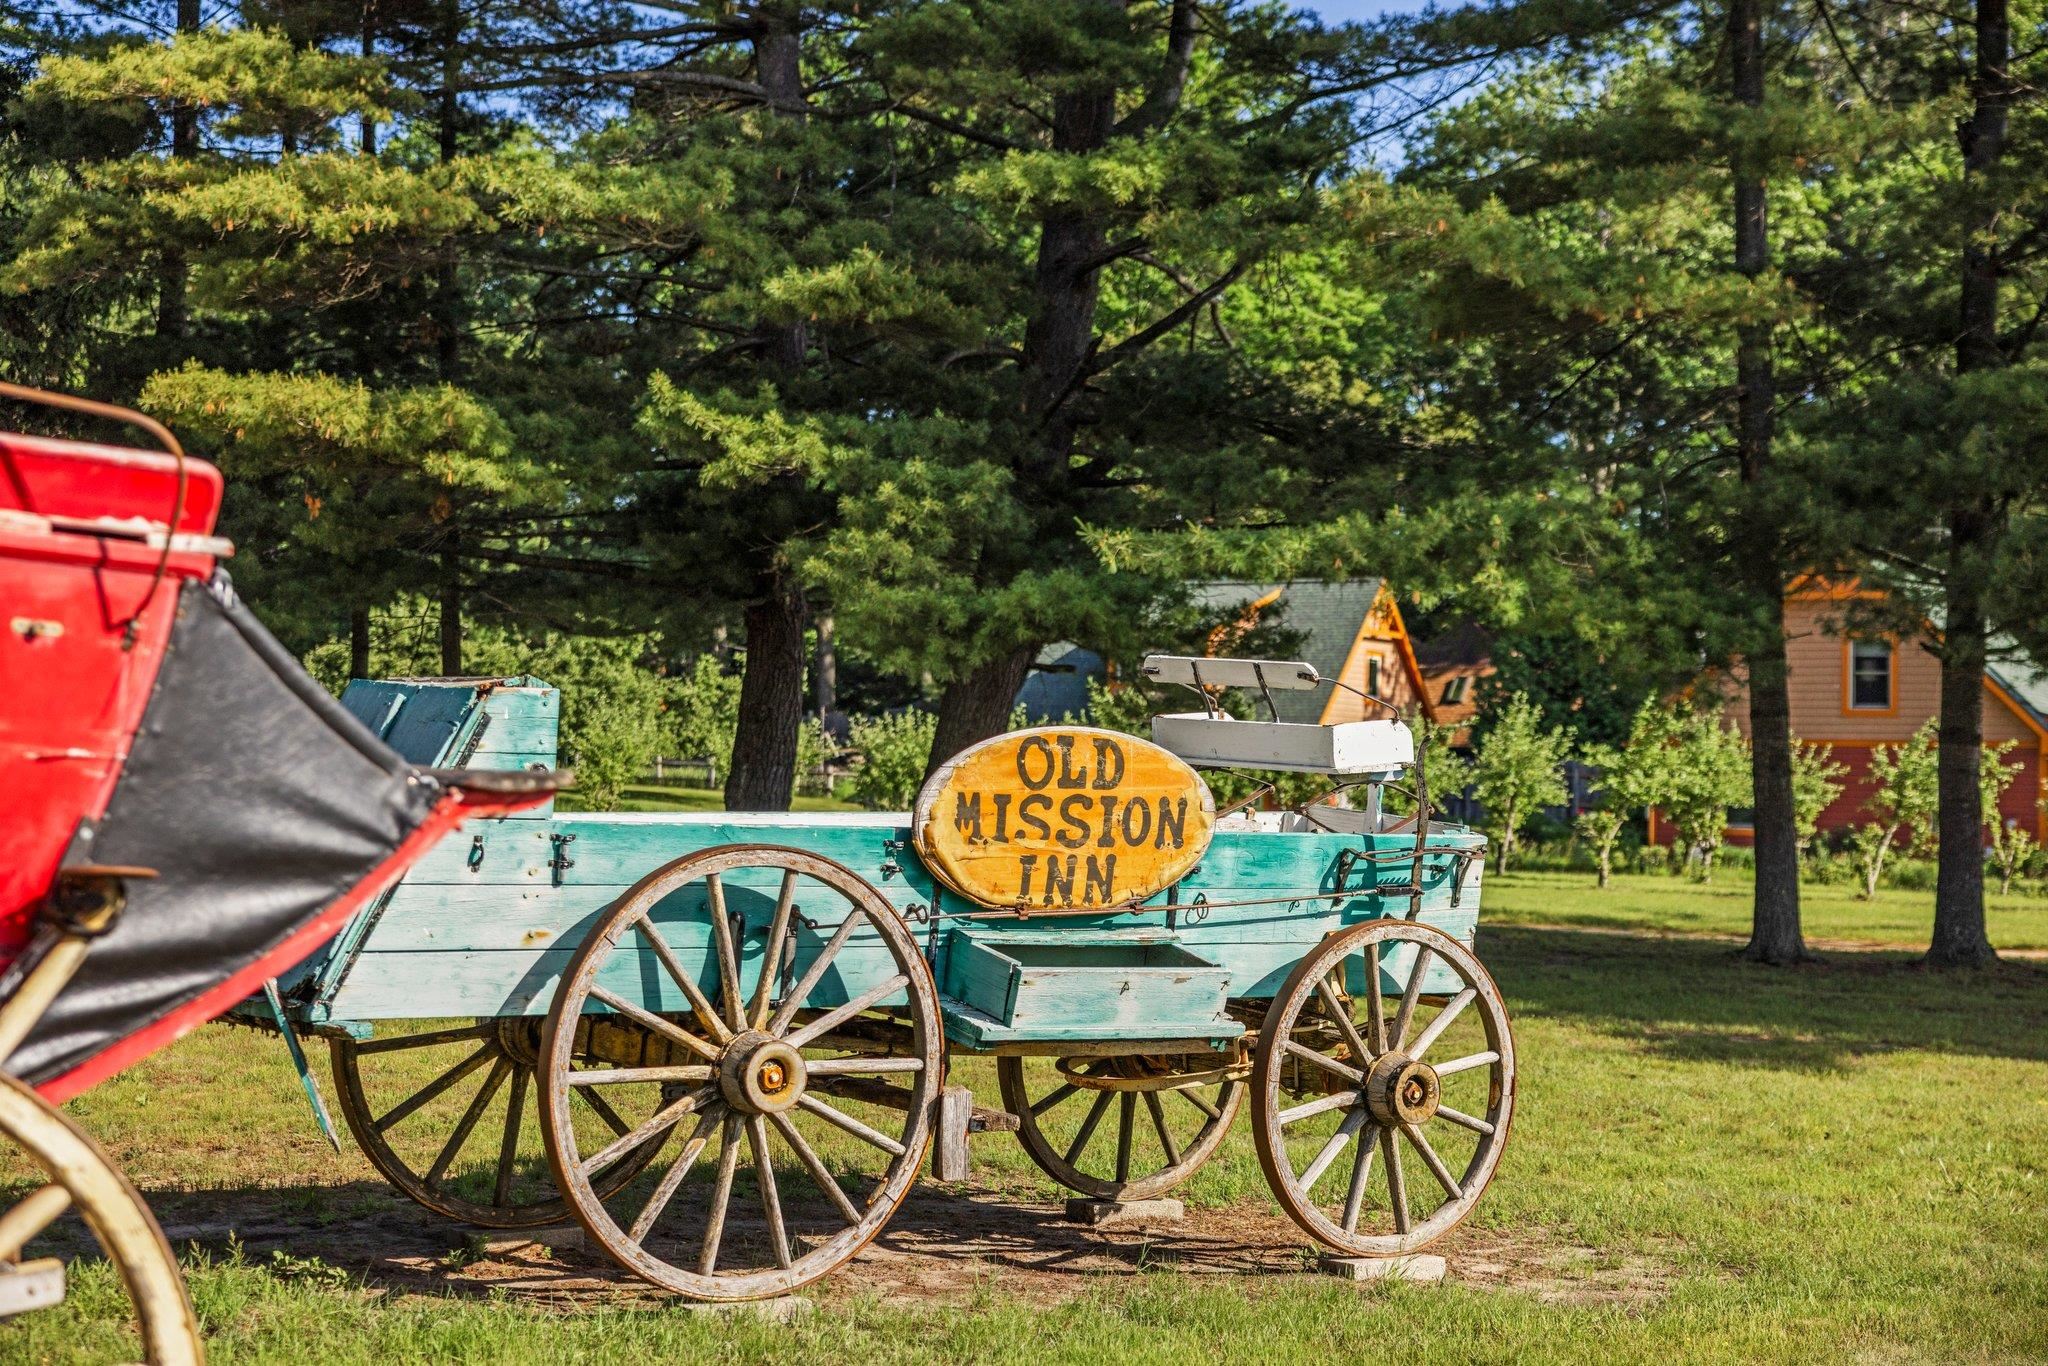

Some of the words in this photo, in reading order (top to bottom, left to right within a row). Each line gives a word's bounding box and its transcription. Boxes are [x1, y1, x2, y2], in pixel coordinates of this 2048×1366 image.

[1017, 735, 1125, 791] OLD
[954, 791, 1188, 850] MISSION
[1016, 853, 1117, 907] INN
